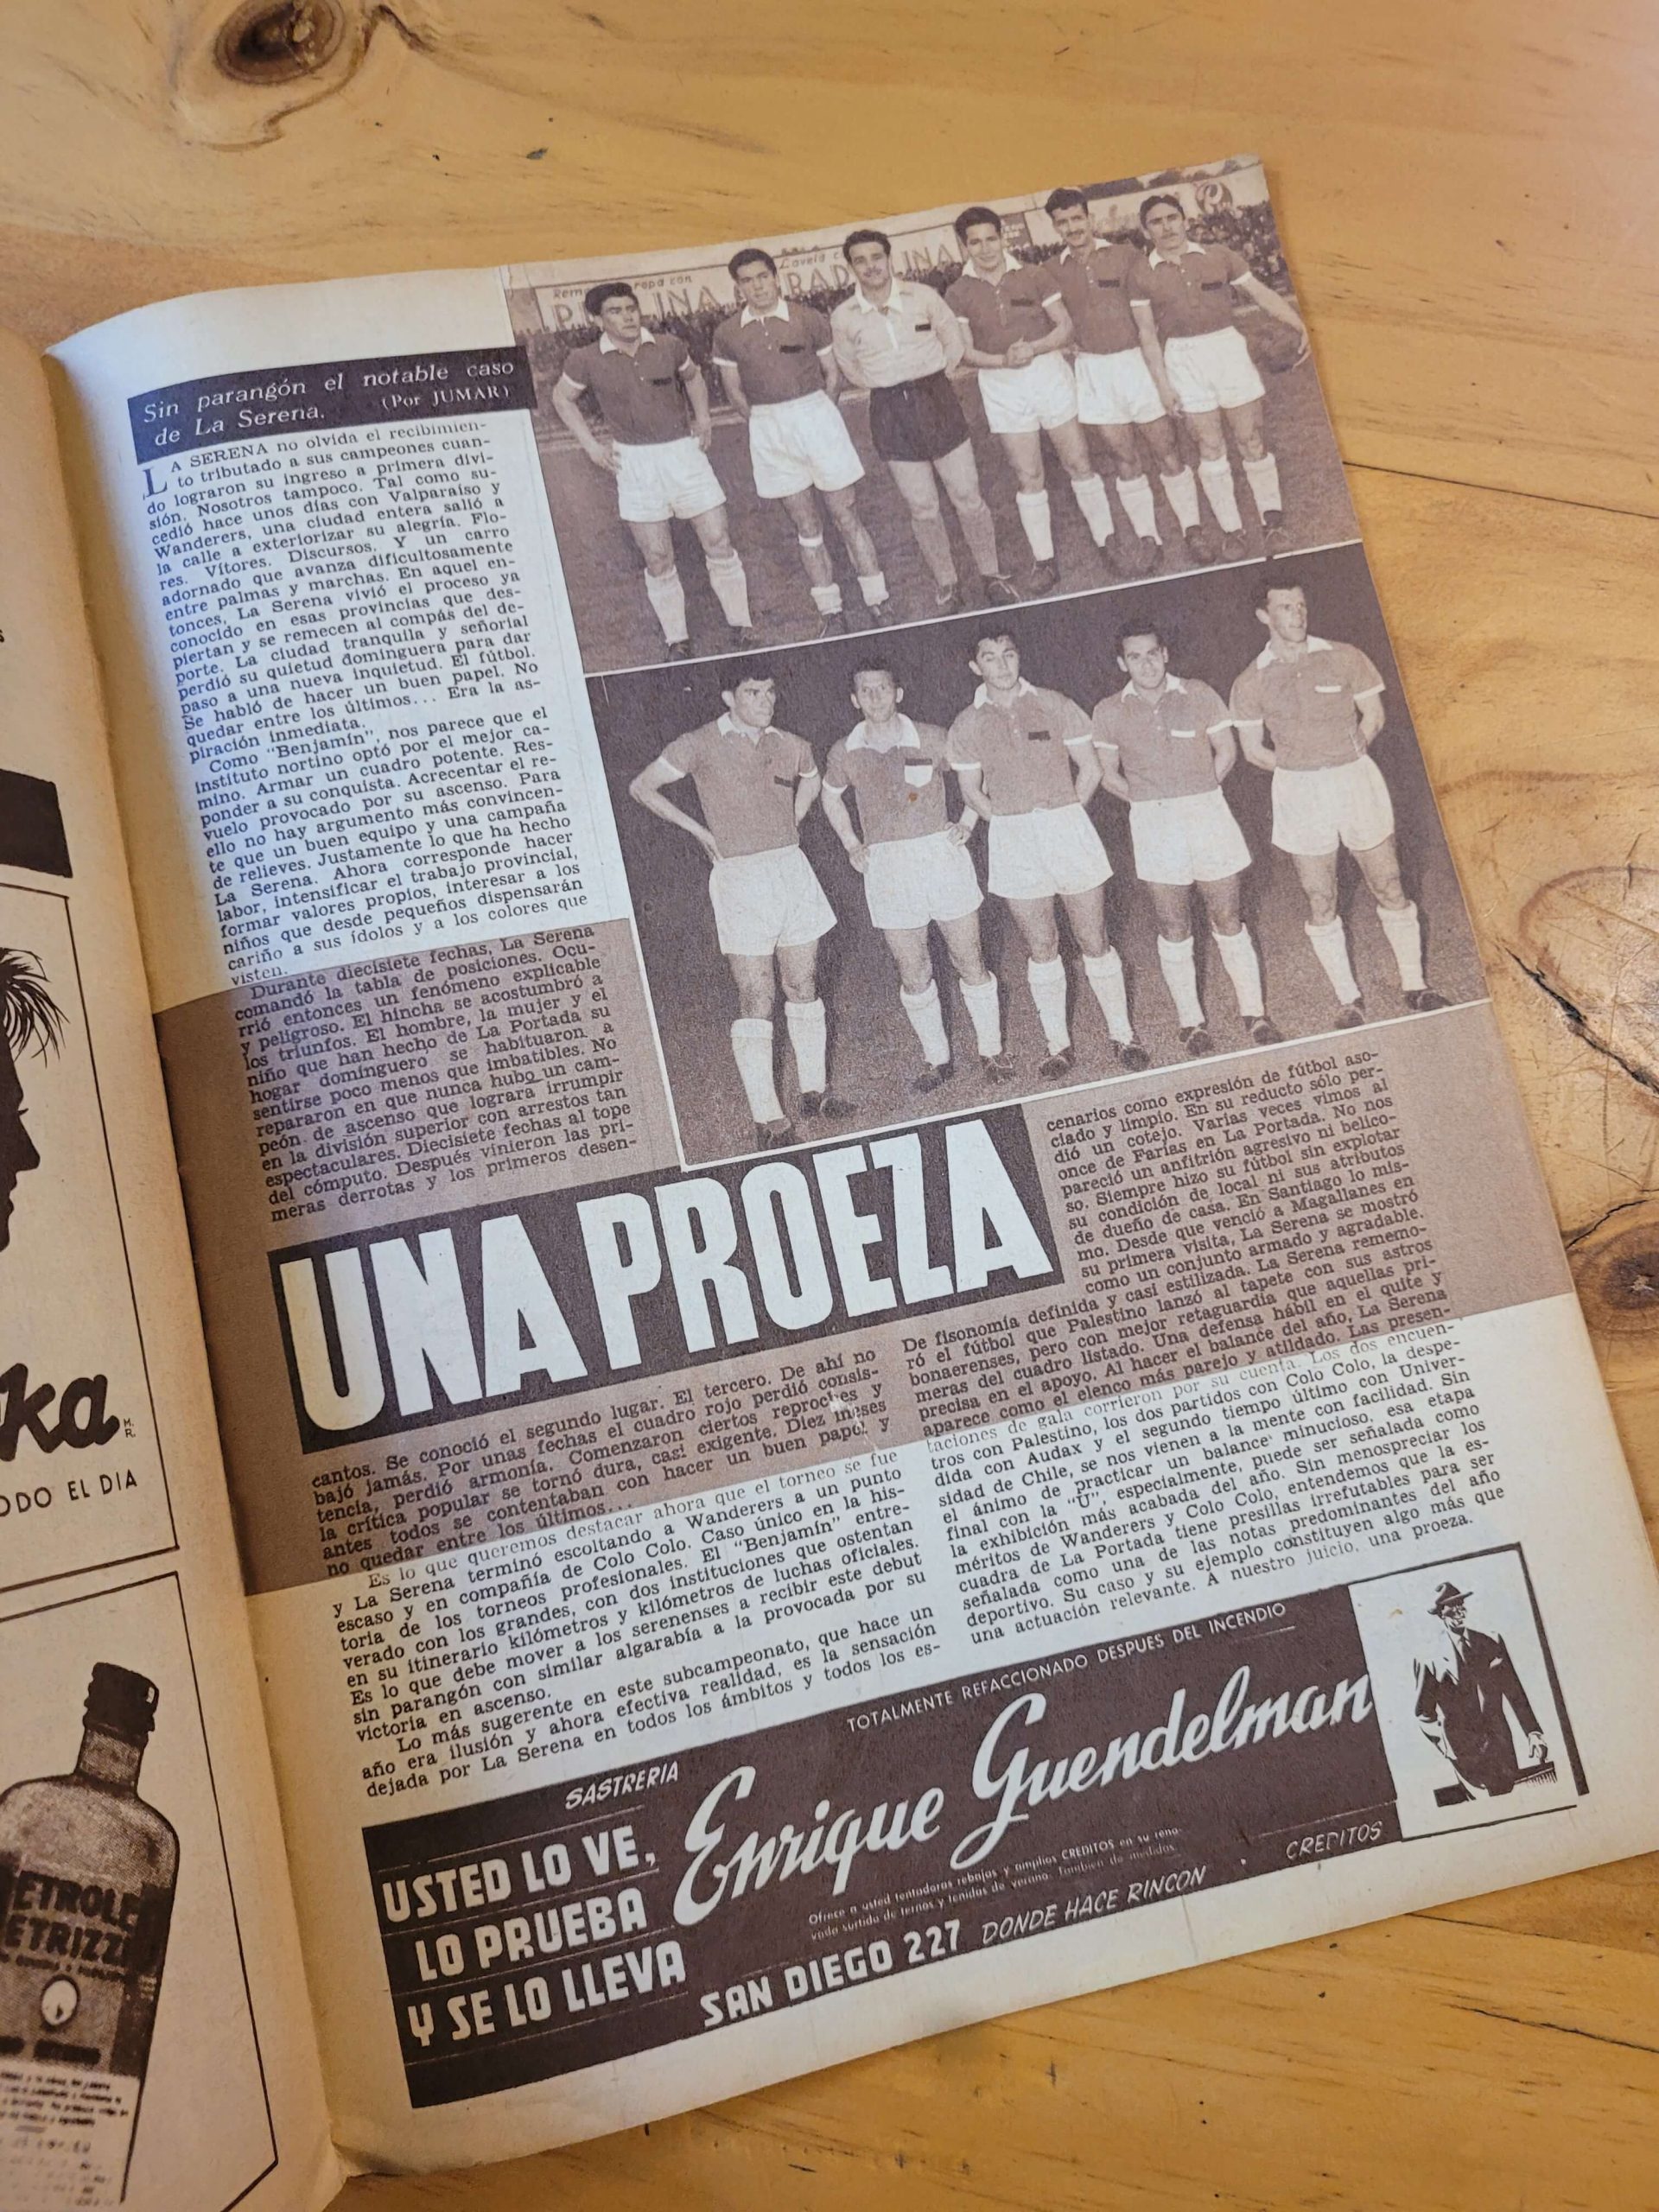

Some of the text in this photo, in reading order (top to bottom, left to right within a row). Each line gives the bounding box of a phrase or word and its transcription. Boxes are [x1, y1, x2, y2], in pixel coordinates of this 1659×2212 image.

[143, 362, 513, 423] Sin parangón el notable caso
[155, 406, 324, 446] de La Serena.
[381, 385, 509, 410] (Por JUMAR)
[177, 438, 490, 487] to tributado a sus campeones cuan-
[151, 522, 194, 545] cedió
[202, 515, 243, 531] hace
[252, 506, 294, 521] unos
[303, 499, 339, 513] días
[348, 495, 378, 508] con
[491, 482, 499, 495] y
[162, 541, 512, 607] adornado que avanza dificultosamente
[209, 753, 258, 773] Como
[388, 727, 418, 740] nos
[426, 717, 484, 737] parece
[493, 712, 523, 727] que
[532, 706, 548, 720] el
[208, 800, 567, 874] te que un buen equipo y una campaña
[248, 923, 594, 1000] Durante diecisiete fechas, La Serena
[268, 1118, 633, 1205] del cómputo. Después vinieron las pri-
[1057, 1162, 1097, 1180] once
[1104, 1154, 1125, 1170] de
[1195, 1135, 1217, 1149] en
[1222, 1128, 1247, 1143] La
[1252, 1111, 1325, 1136] Portada.
[1332, 1103, 1357, 1119] No
[1363, 1096, 1393, 1112] nos
[279, 1119, 1054, 1432] UNA PROEZA
[1084, 1207, 1424, 1294] como un conjunto armado y agradable.
[67, 1479, 91, 1502] EL
[99, 1469, 137, 1496] DIA
[958, 1453, 1494, 1592] cuadra de La Portada tiene presillas irrefutables para ser
[346, 1538, 918, 1688] en su itinerario kilómetros y kilómetros de luchas oficiales.
[396, 1606, 933, 1753] Lo más sugerente en este subcampeonato, que hace un
[847, 1602, 1287, 1733] TOTALMENTE REFACCIONADO DESPUES DEL INCENDIO
[565, 1760, 679, 1810] SASTRERIA
[673, 1664, 1374, 1926] Enrique Guendelman
[381, 1824, 657, 1923] USTED LO VE,
[1061, 1839, 1115, 1859] CREDITOS
[415, 1887, 648, 1981] LO PRUEBA
[698, 1865, 1207, 2027] SAN DIEGO 227 DONDE HACE RINCON
[407, 1940, 687, 2047] Y SE LO LLEVA
